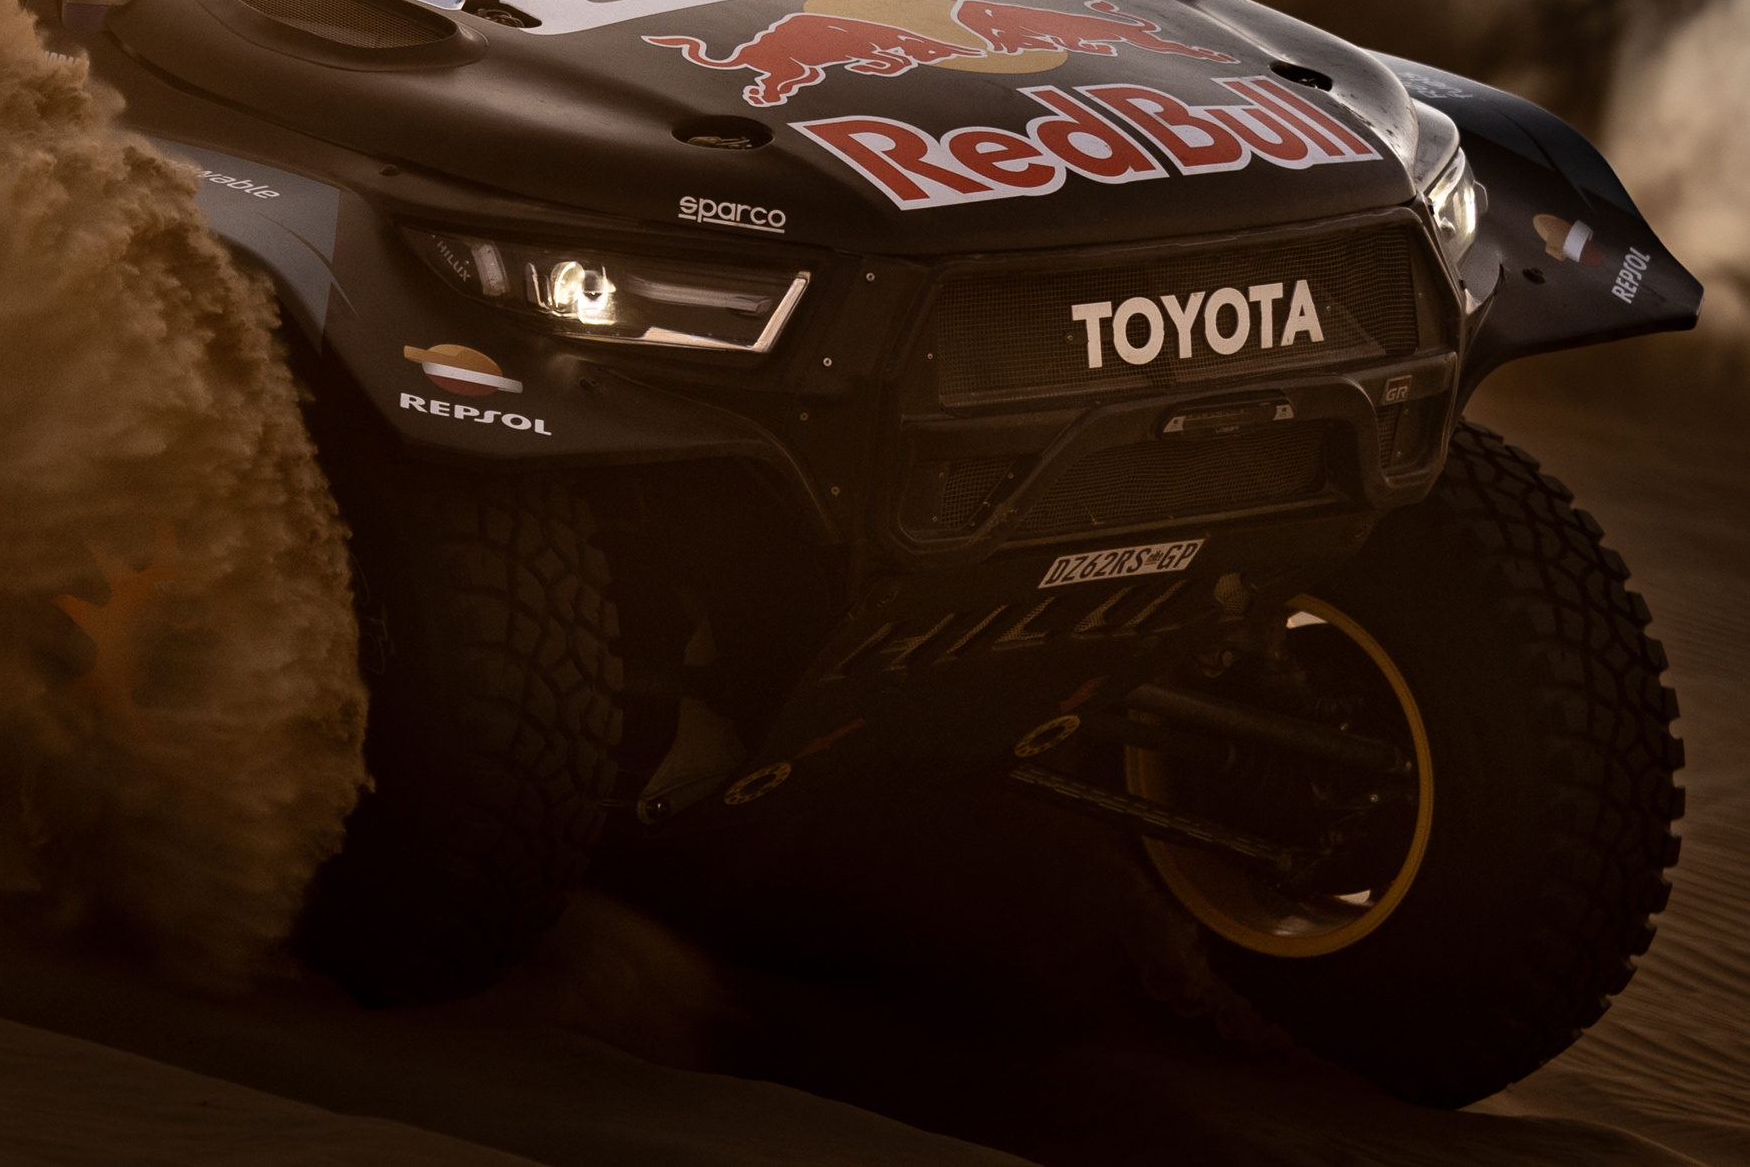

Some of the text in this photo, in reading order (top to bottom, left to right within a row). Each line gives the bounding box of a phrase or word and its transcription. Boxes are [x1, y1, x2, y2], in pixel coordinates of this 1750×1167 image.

[678, 195, 786, 233] sparco
[436, 240, 471, 282] HILUX
[1611, 247, 1650, 304] REPSOL
[1071, 279, 1324, 370] TOYOTA
[399, 392, 552, 436] REPSOL
[1385, 385, 1408, 402] GR
[1157, 542, 1198, 570] GP
